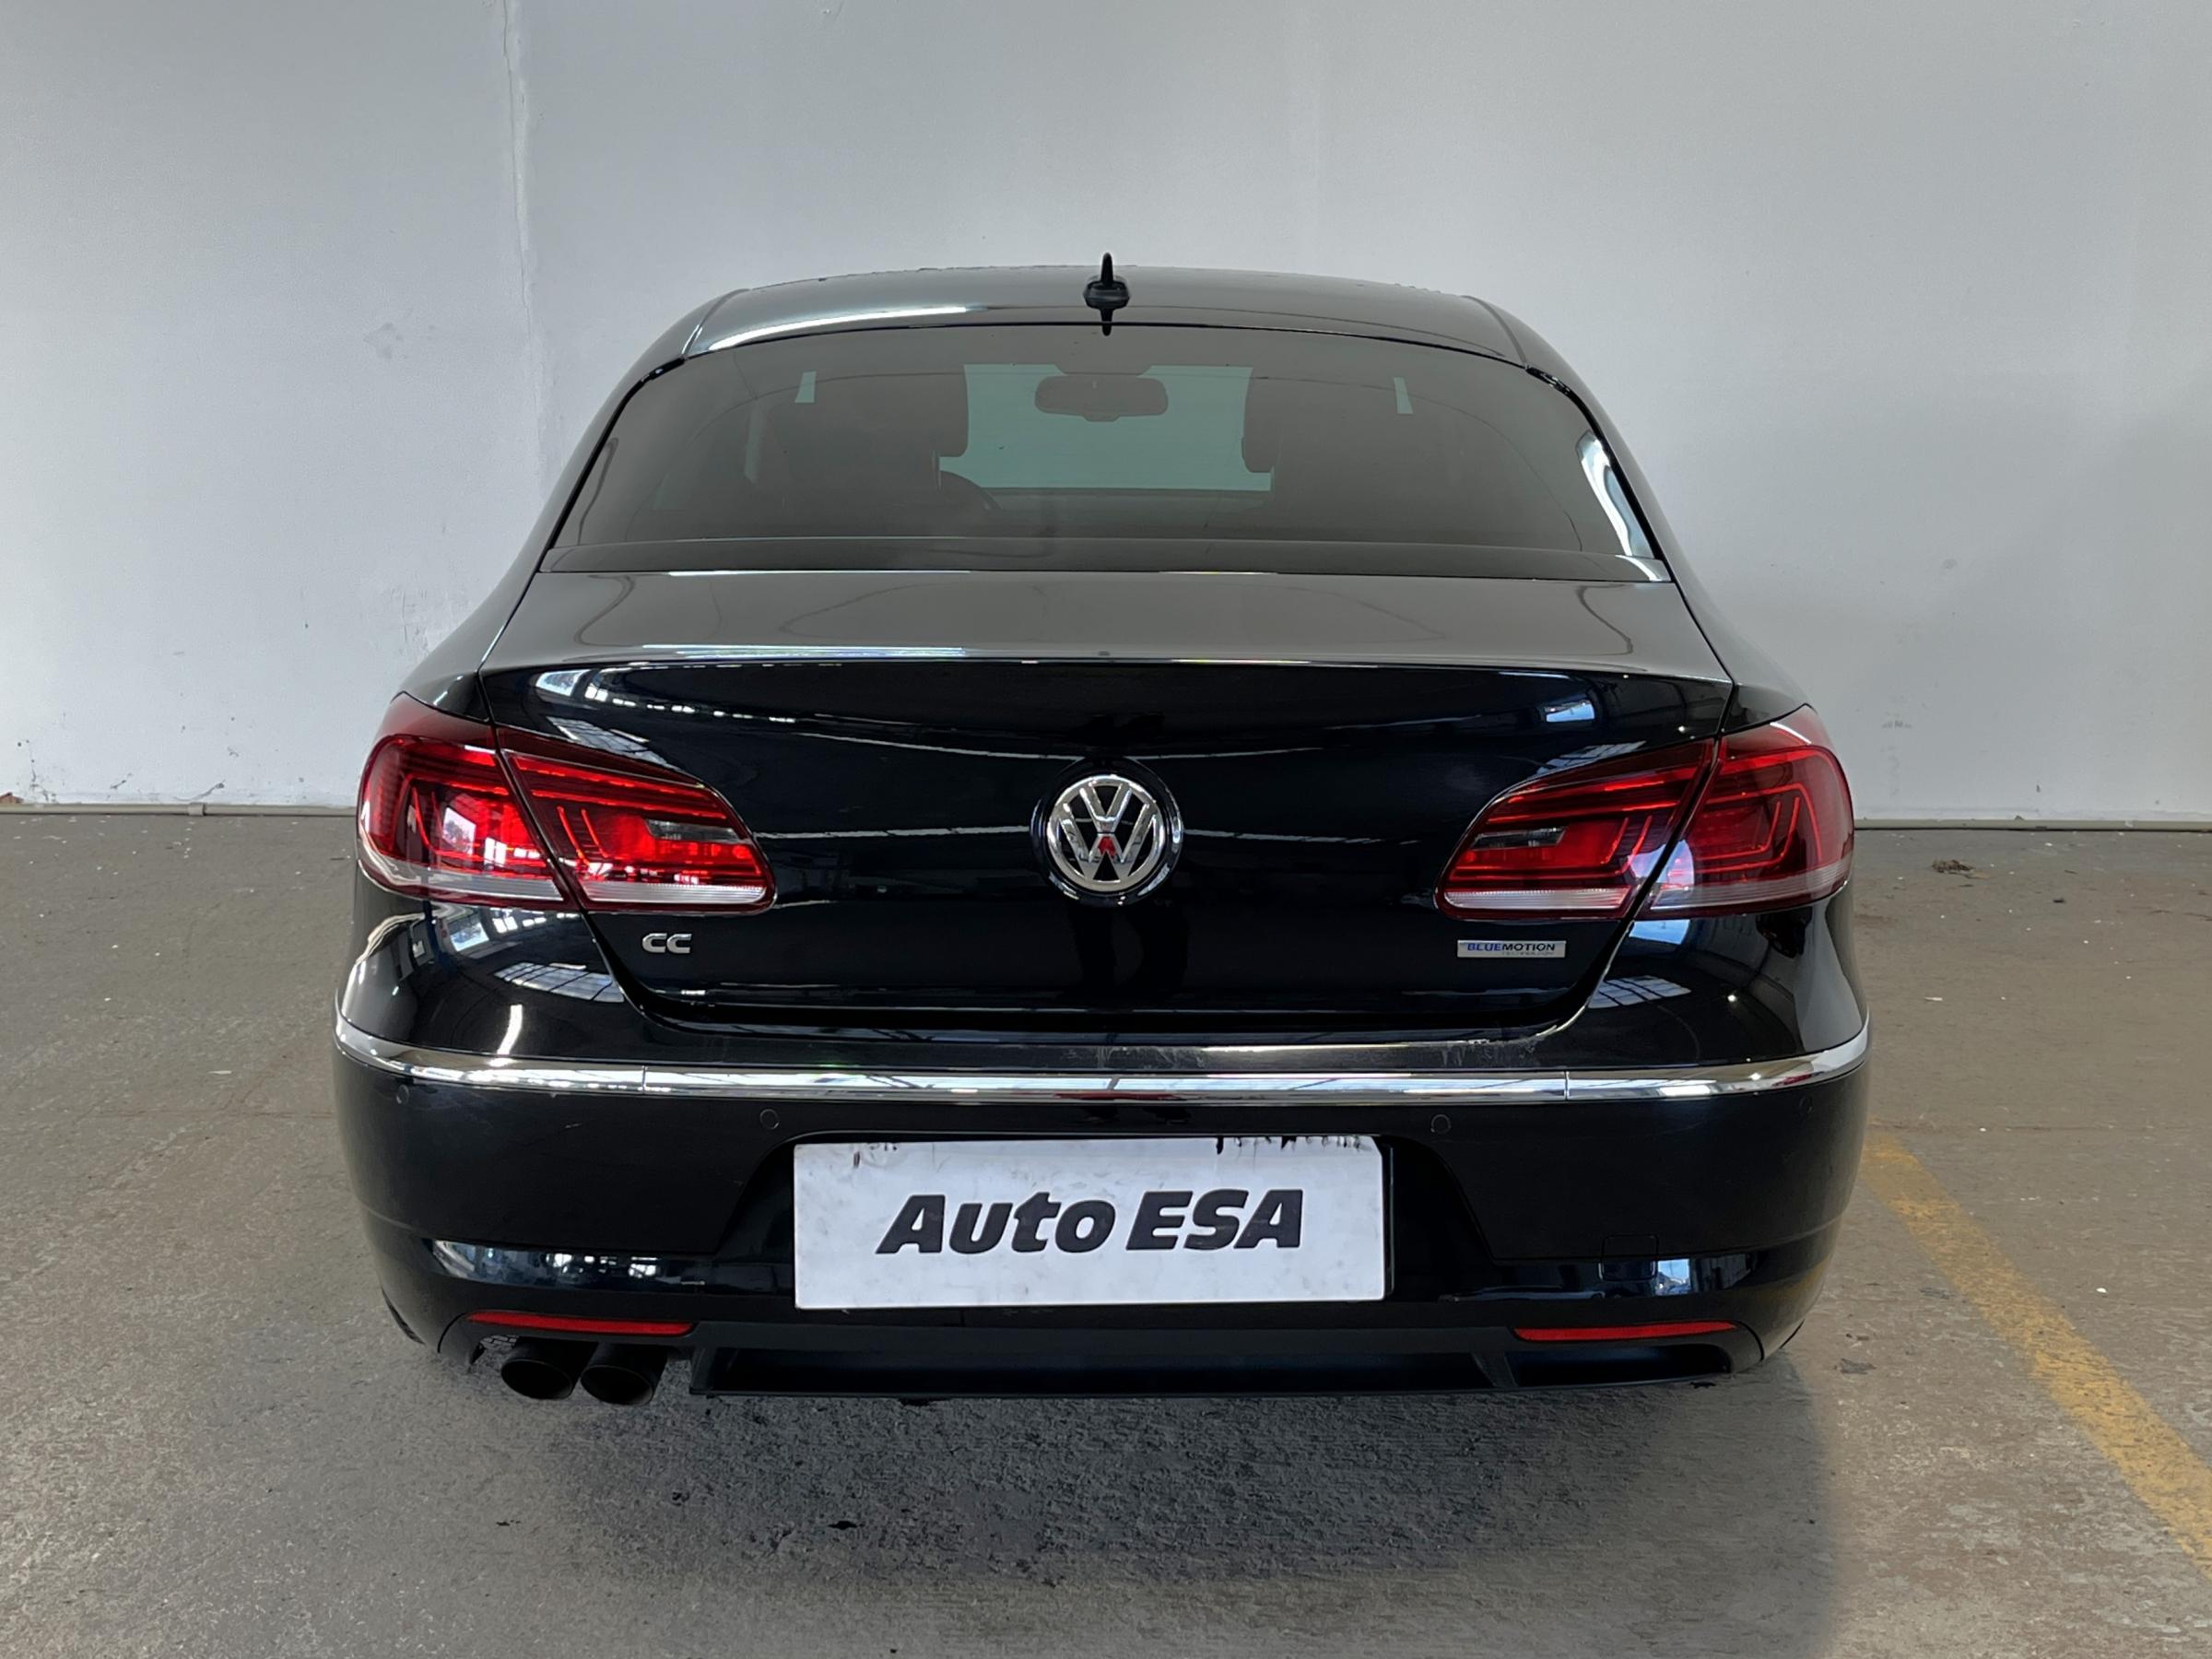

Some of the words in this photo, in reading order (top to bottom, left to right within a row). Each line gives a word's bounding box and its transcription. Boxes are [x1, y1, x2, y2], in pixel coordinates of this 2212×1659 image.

[641, 933, 692, 954] CC
[1466, 943, 1556, 952] BLUEMOTION
[875, 1191, 1117, 1254] Auto
[1125, 1188, 1304, 1252] ESA
